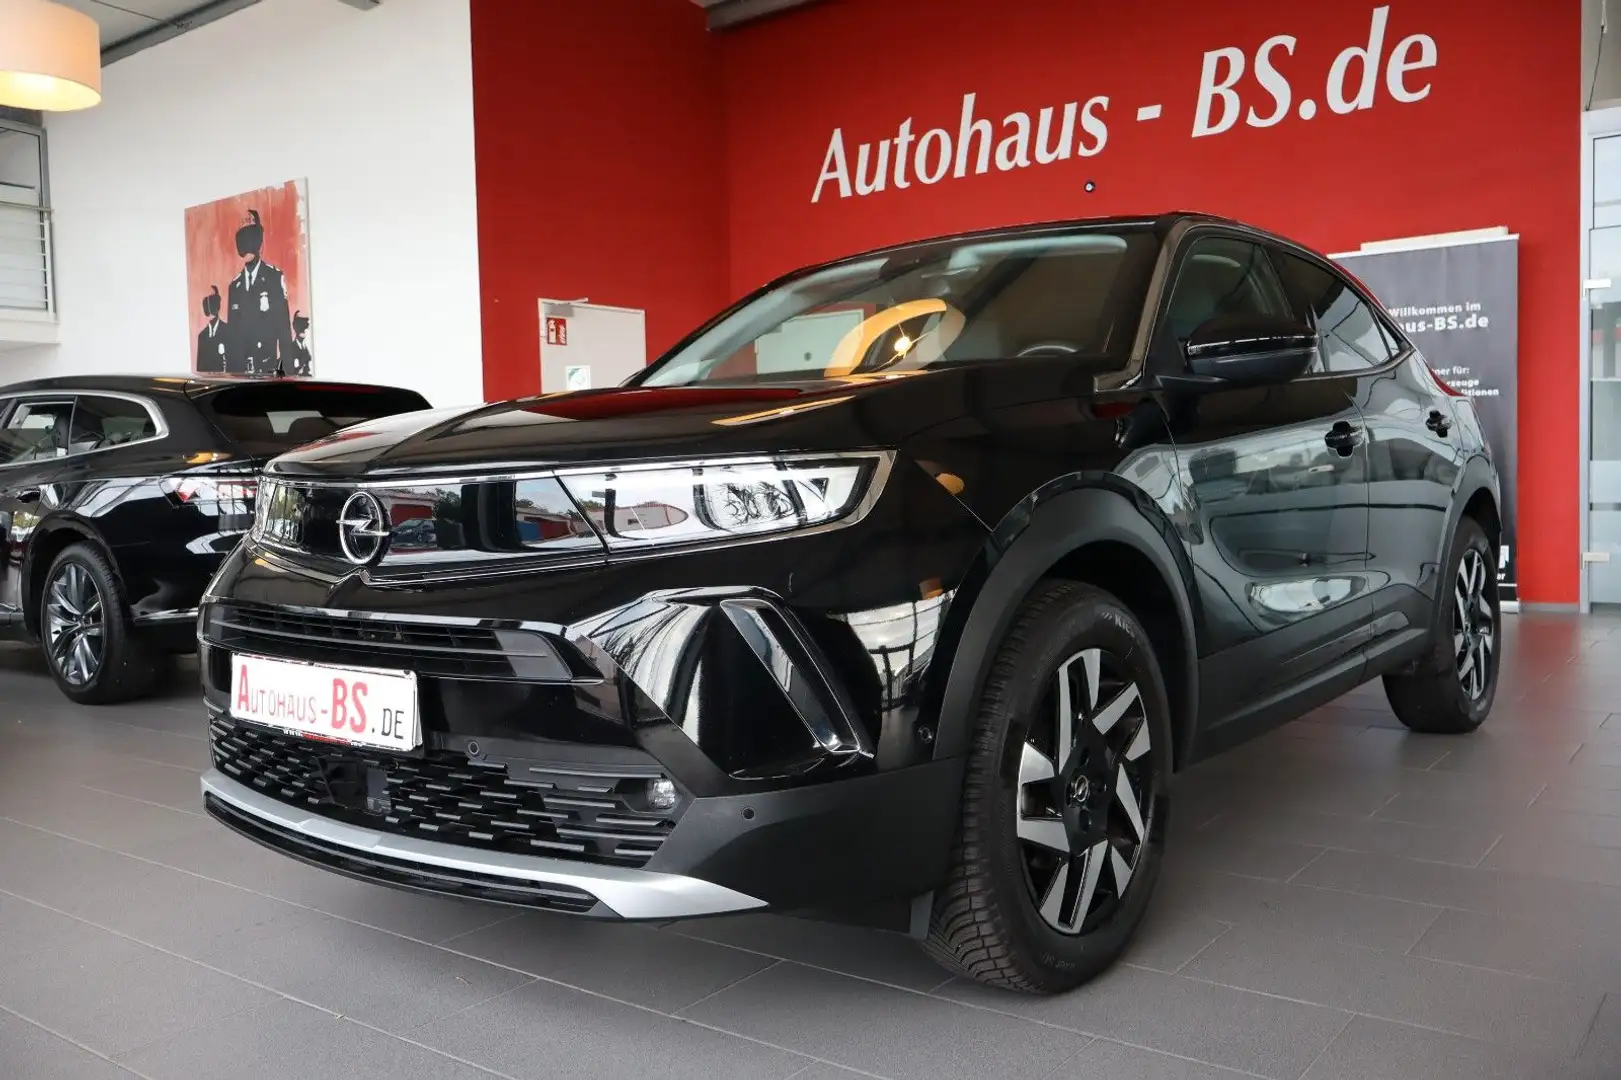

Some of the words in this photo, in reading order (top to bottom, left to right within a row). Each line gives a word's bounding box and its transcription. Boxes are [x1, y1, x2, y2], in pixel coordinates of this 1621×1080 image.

[811, 93, 1109, 203] Autohaus
[1191, 5, 1437, 138] BS.de
[1388, 304, 1463, 317] Willkommen
[1465, 301, 1482, 312] im
